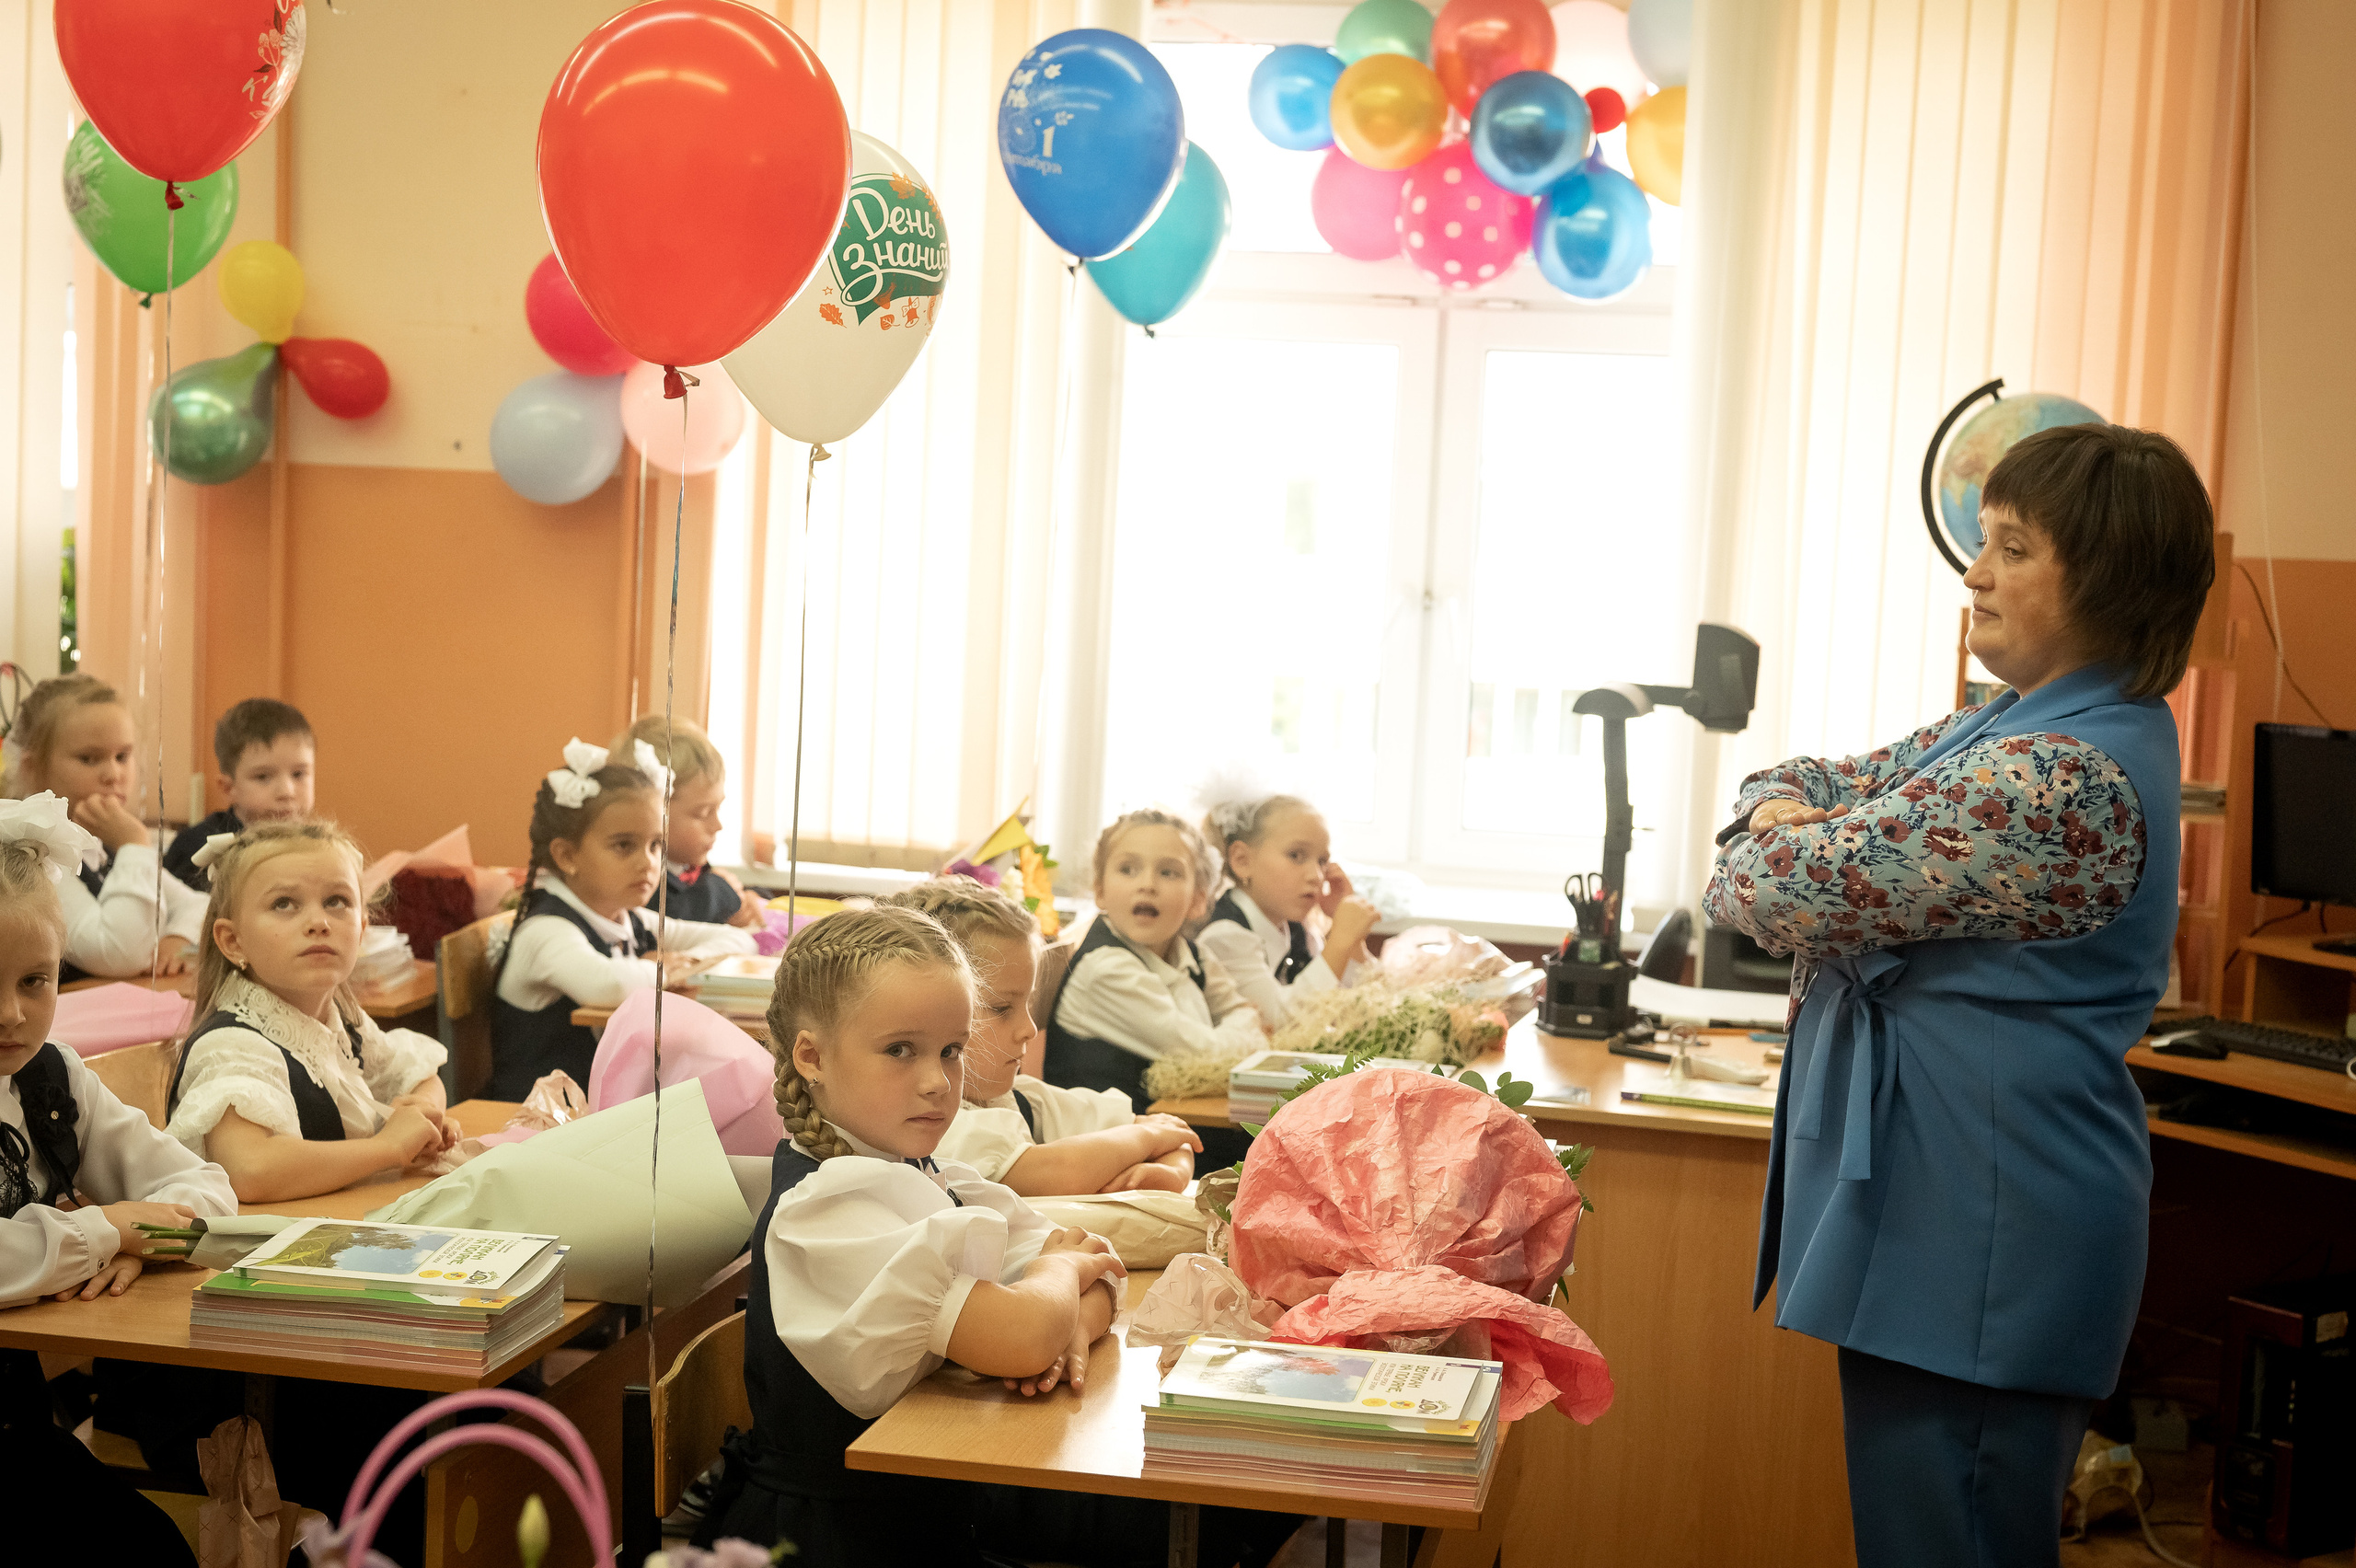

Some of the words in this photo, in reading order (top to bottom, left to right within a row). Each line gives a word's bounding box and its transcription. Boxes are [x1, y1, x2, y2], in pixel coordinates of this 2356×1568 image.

[1042, 125, 1056, 157] 1
[848, 187, 936, 241] День
[841, 239, 950, 284] Знаний
[1407, 1364, 1430, 1389] ВЕЛИКАН
